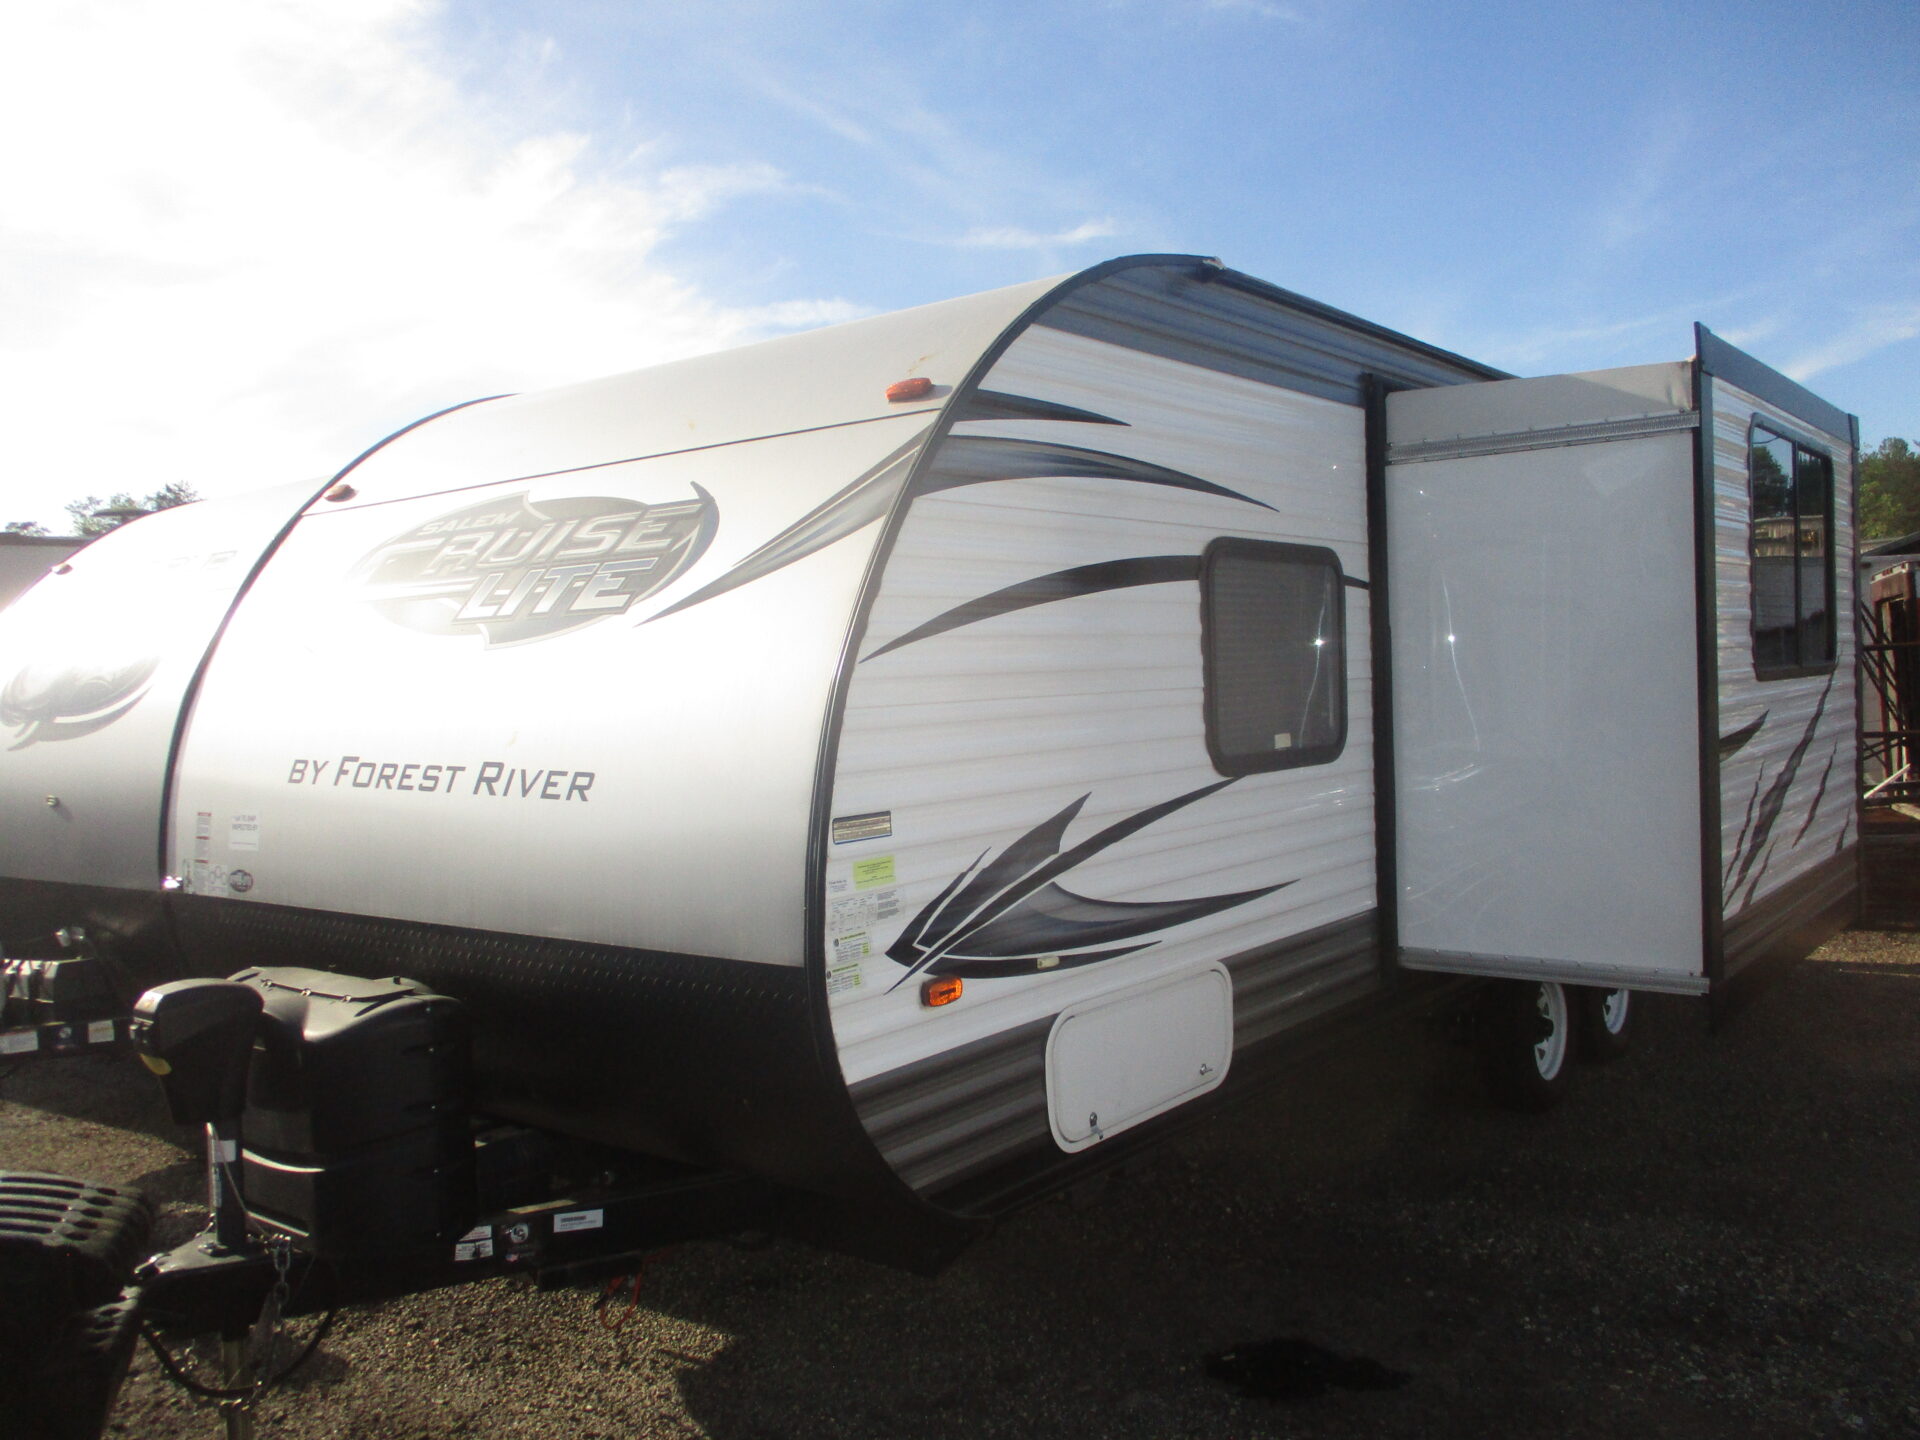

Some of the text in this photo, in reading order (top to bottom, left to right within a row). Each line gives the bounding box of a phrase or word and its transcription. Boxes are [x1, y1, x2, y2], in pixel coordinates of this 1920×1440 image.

[360, 503, 702, 599] CRUISE
[418, 512, 514, 537] SALEM
[453, 557, 660, 624] LITE
[289, 756, 596, 802] BY FOREST RIVER
